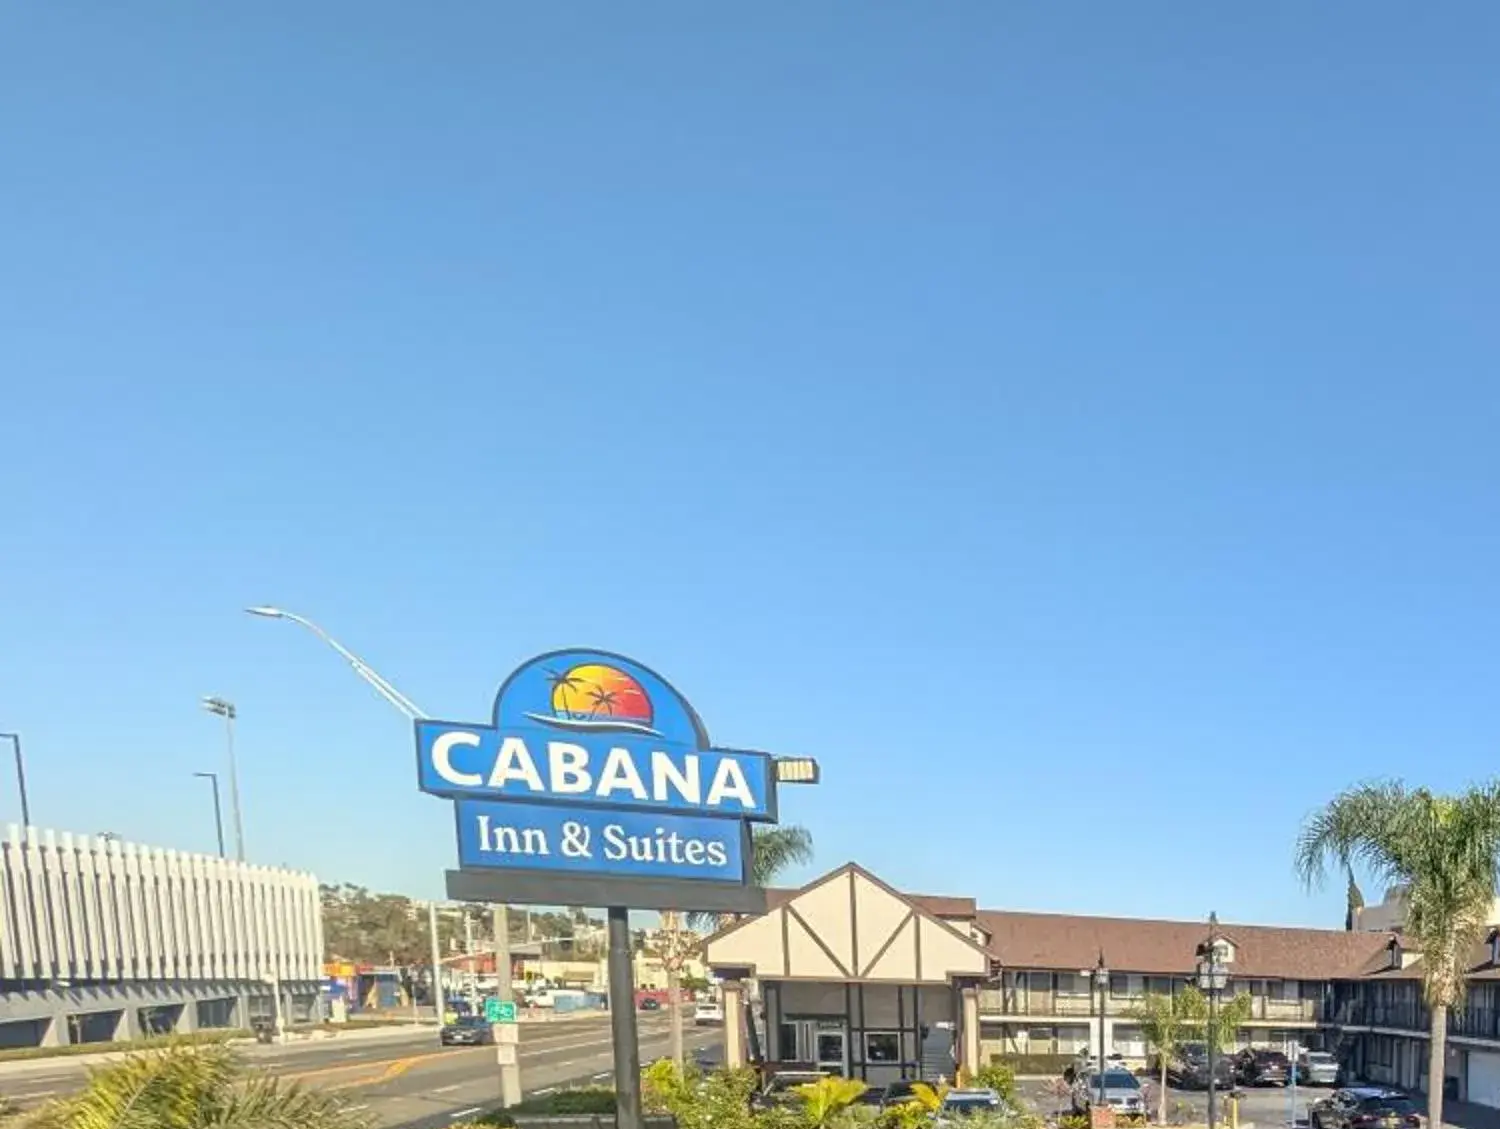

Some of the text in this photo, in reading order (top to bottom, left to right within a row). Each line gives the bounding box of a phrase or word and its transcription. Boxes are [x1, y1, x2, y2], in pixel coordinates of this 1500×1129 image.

[432, 731, 756, 809] CABANA
[476, 815, 727, 867] Inn & Suites
